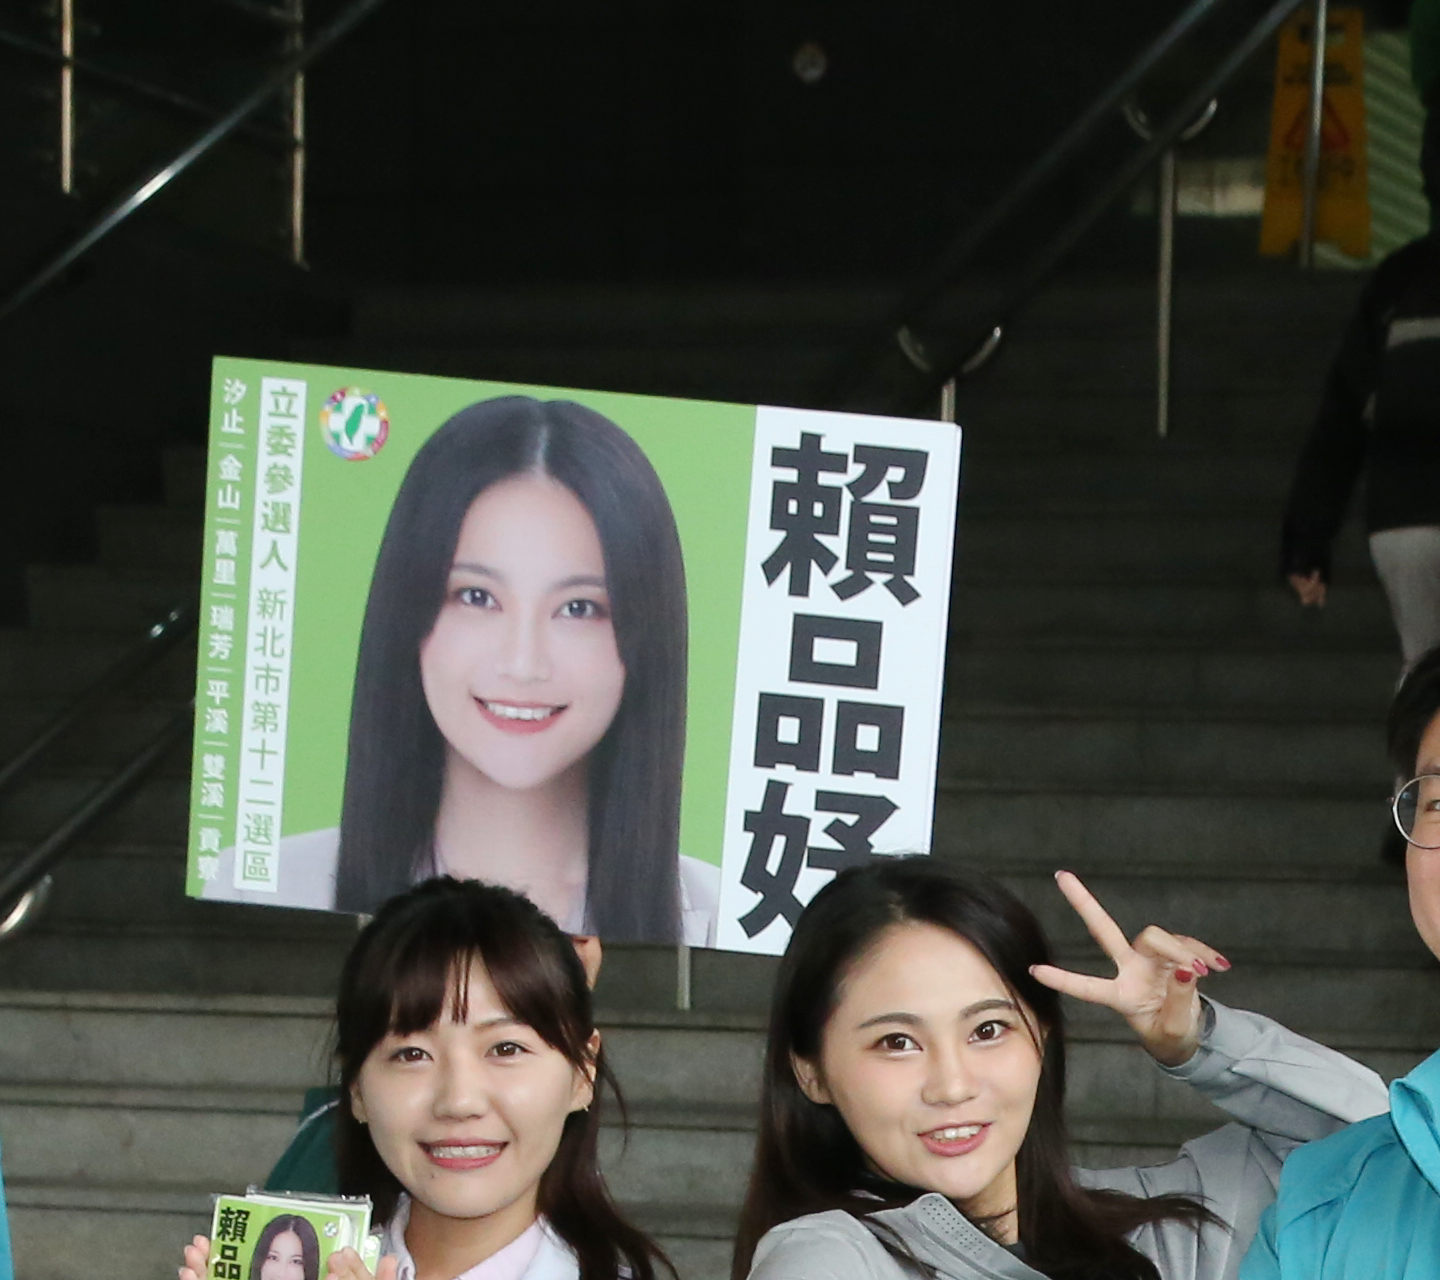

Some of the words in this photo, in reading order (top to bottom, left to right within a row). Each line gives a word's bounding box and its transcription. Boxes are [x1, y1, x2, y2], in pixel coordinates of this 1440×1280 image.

[221, 377, 247, 435] 汐止
[217, 453, 242, 511] 金山
[260, 385, 299, 573] 立委參選人
[242, 588, 288, 883] 新北市第十二選區
